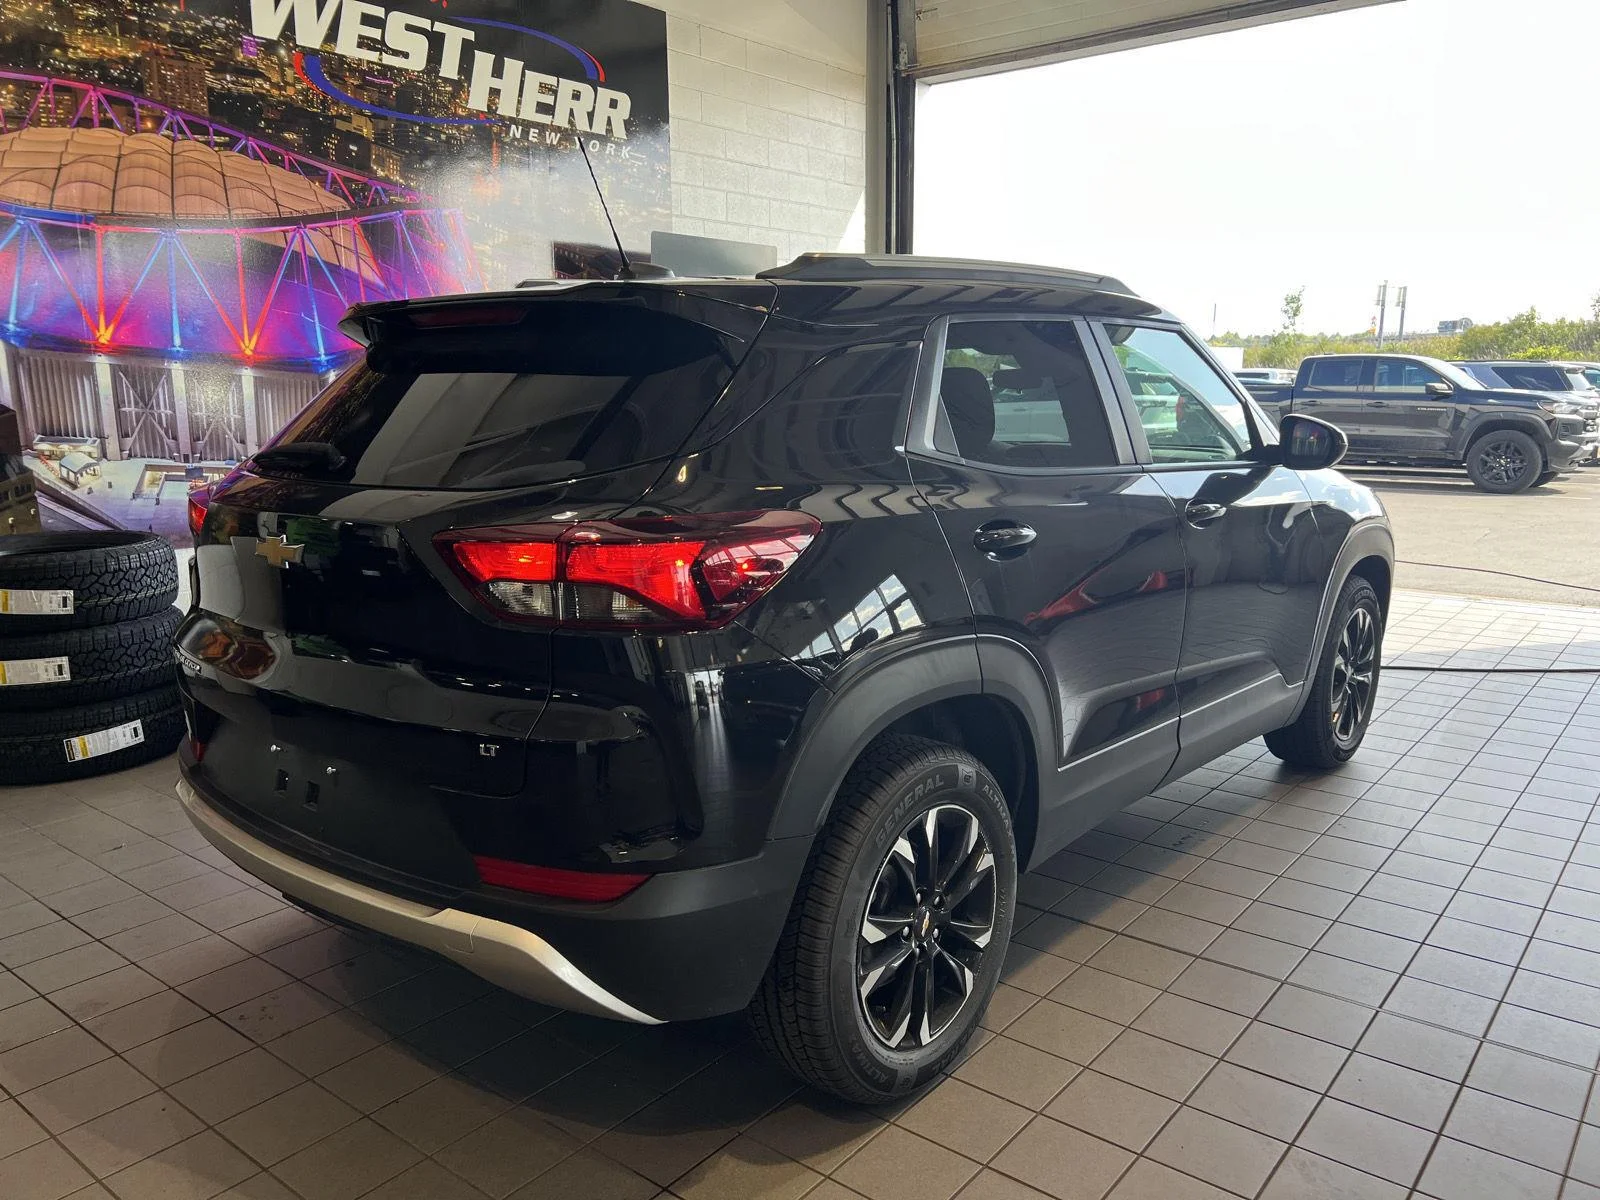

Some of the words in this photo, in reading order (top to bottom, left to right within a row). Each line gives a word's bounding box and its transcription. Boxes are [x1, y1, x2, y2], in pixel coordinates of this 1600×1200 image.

[250, 0, 475, 79] WEST
[467, 50, 631, 139] HERR
[509, 124, 561, 146] NEW
[574, 136, 631, 159] YORK
[479, 743, 499, 757] LT
[875, 774, 944, 846] GENERAL
